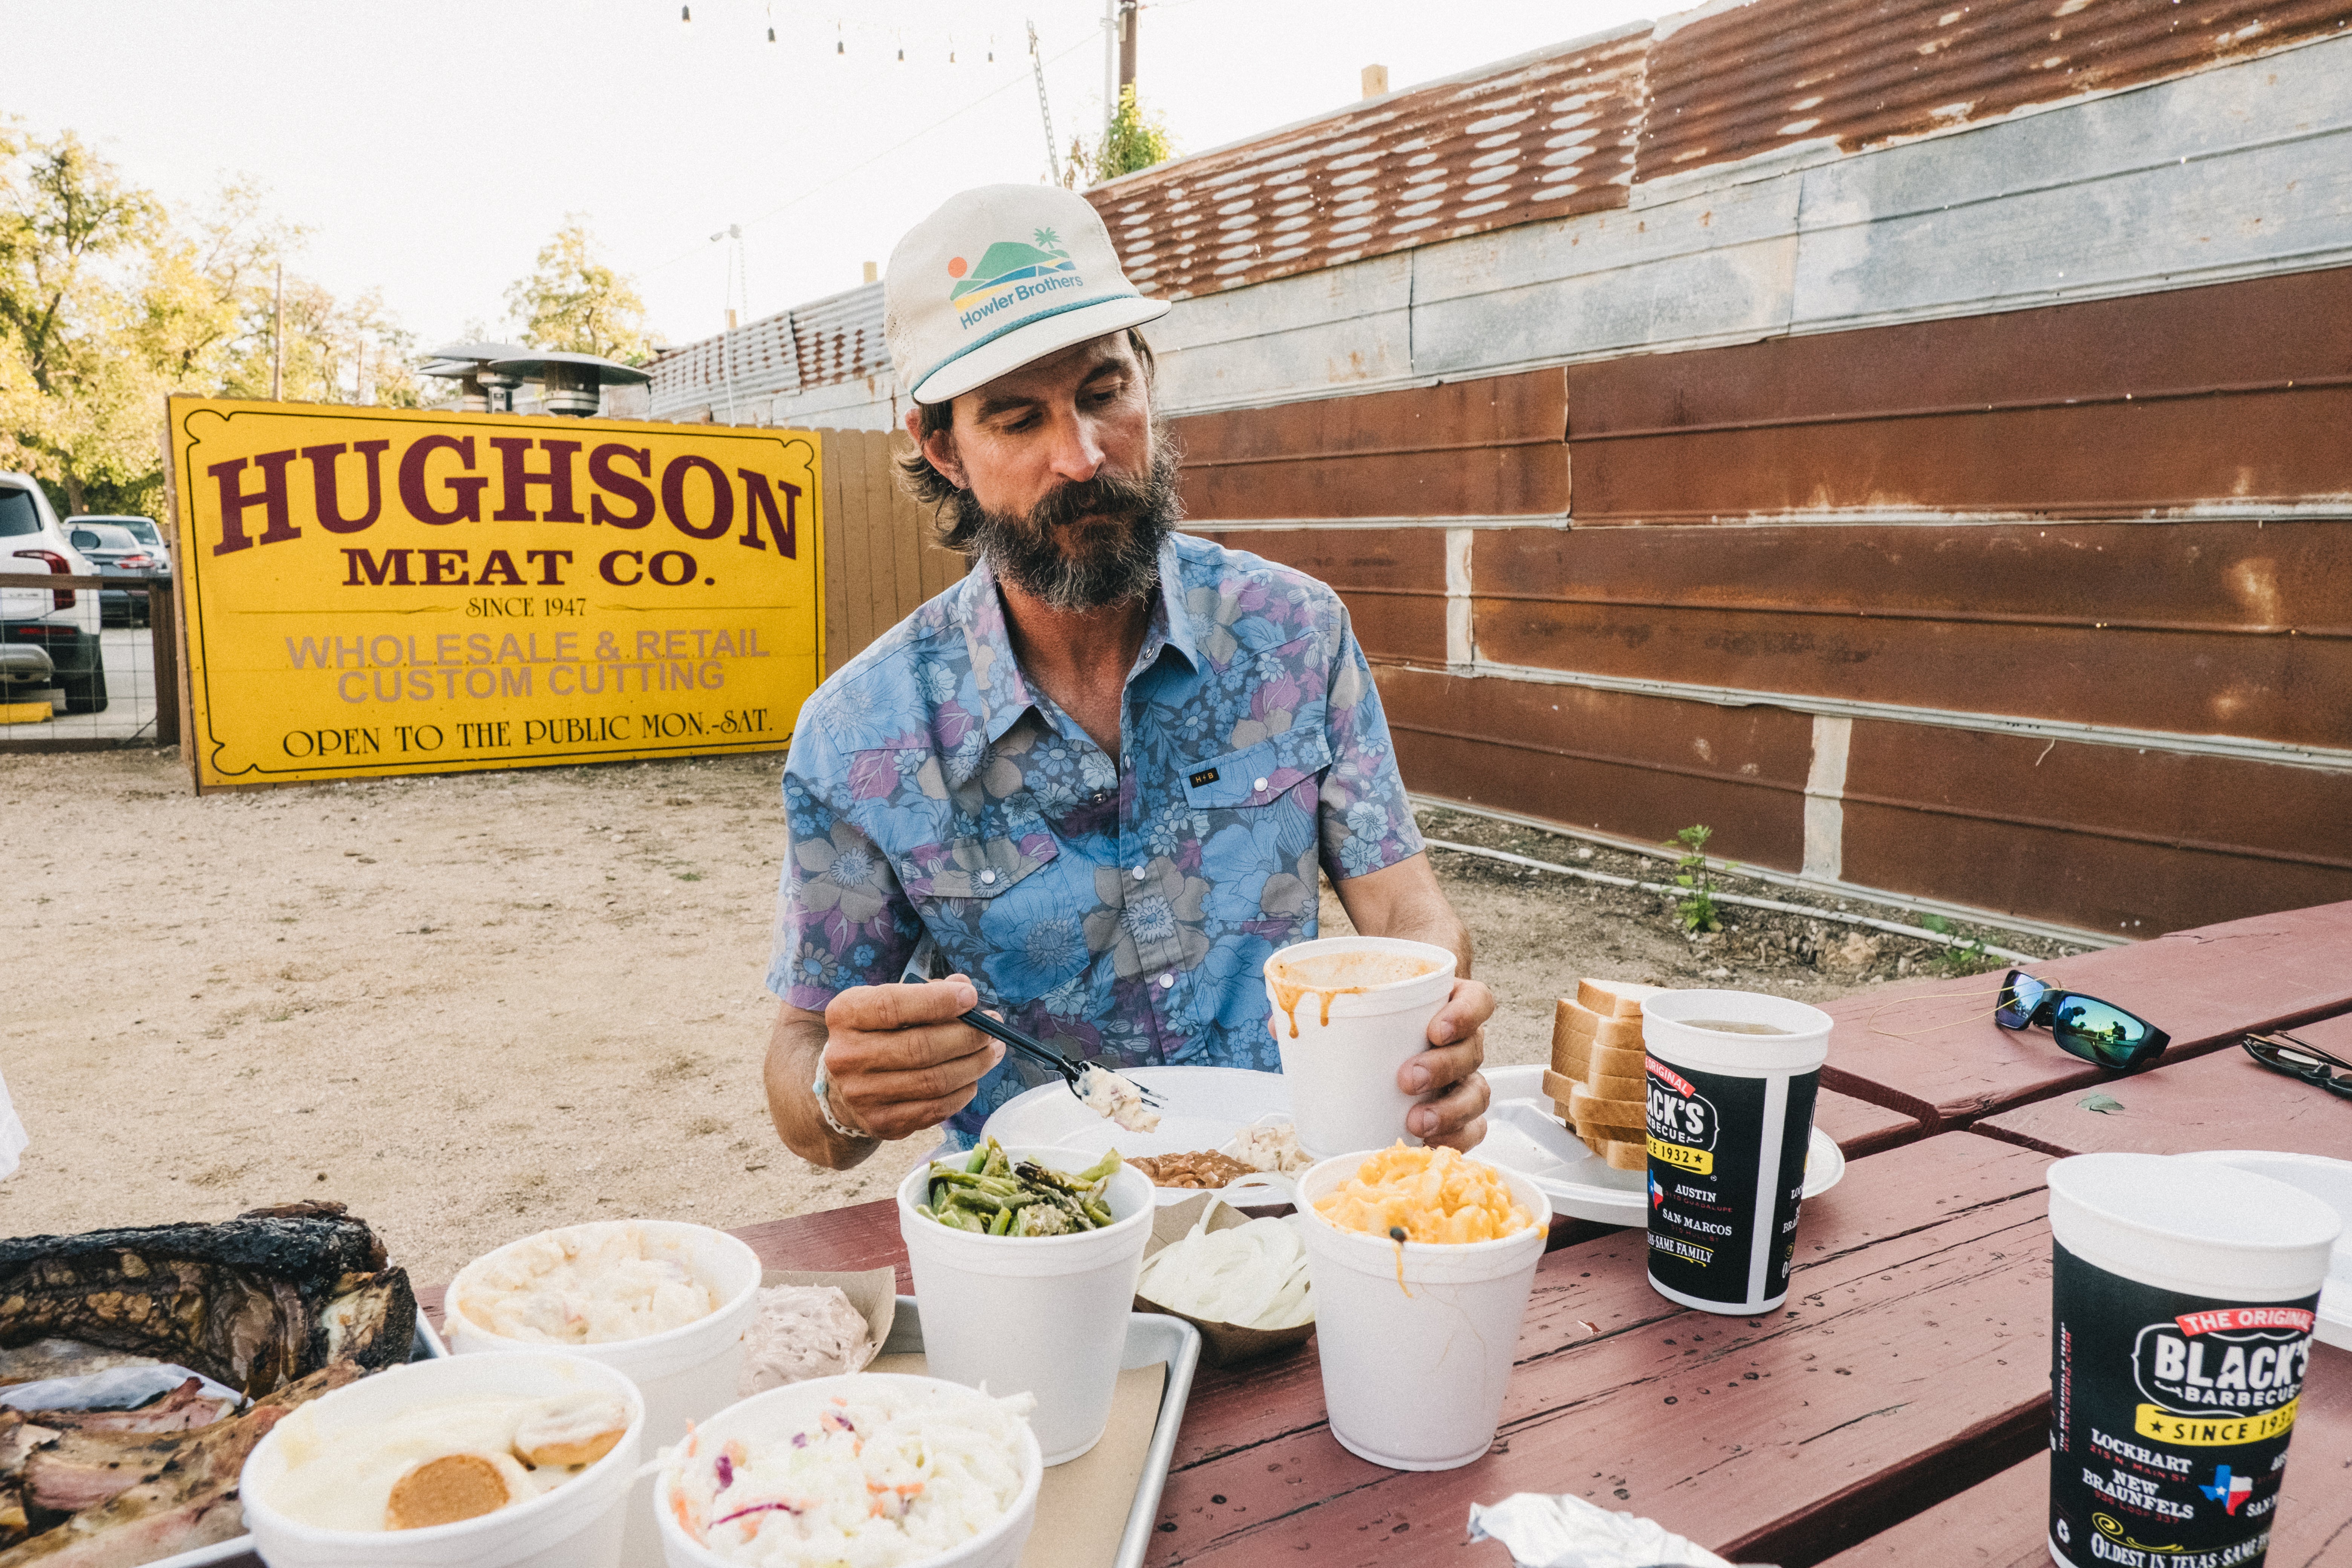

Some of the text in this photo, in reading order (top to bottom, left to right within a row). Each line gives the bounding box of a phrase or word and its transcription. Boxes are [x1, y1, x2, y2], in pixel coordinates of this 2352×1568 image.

[960, 276, 1083, 330] Howler Brothers
[208, 434, 802, 561] HUGHSON
[340, 548, 715, 587] MEAT CO.
[465, 596, 586, 619] SINCE 1947
[286, 629, 770, 670] WHOLESALE & RETAIL
[337, 661, 725, 704] CUSTOM CUTTING
[283, 728, 381, 758] OPEN
[395, 725, 444, 753] TO
[456, 721, 510, 749] THE
[524, 715, 631, 746] PUBLIC
[1648, 1060, 1687, 1095] ORIGINAL
[1646, 1083, 1704, 1134] ACK'S
[1647, 1115, 1685, 1143] RBECUE
[1662, 1146, 1689, 1163] 1932
[1675, 1184, 1716, 1203] AUSTIN
[1683, 1198, 1733, 1213] GUADALUPE
[1663, 1208, 1732, 1236] SAN MARCOS
[1677, 1242, 1712, 1263] FAMILY
[2184, 1312, 2232, 1332] THE
[2154, 1334, 2312, 1390] BLACK'S
[2185, 1385, 2296, 1407] BARBECUE
[2174, 1423, 2248, 1441] SINCE
[2091, 1427, 2193, 1474] LOCKHART
[2082, 1467, 2194, 1519] BRAUNFELS
[2112, 1469, 2159, 1495] NEW
